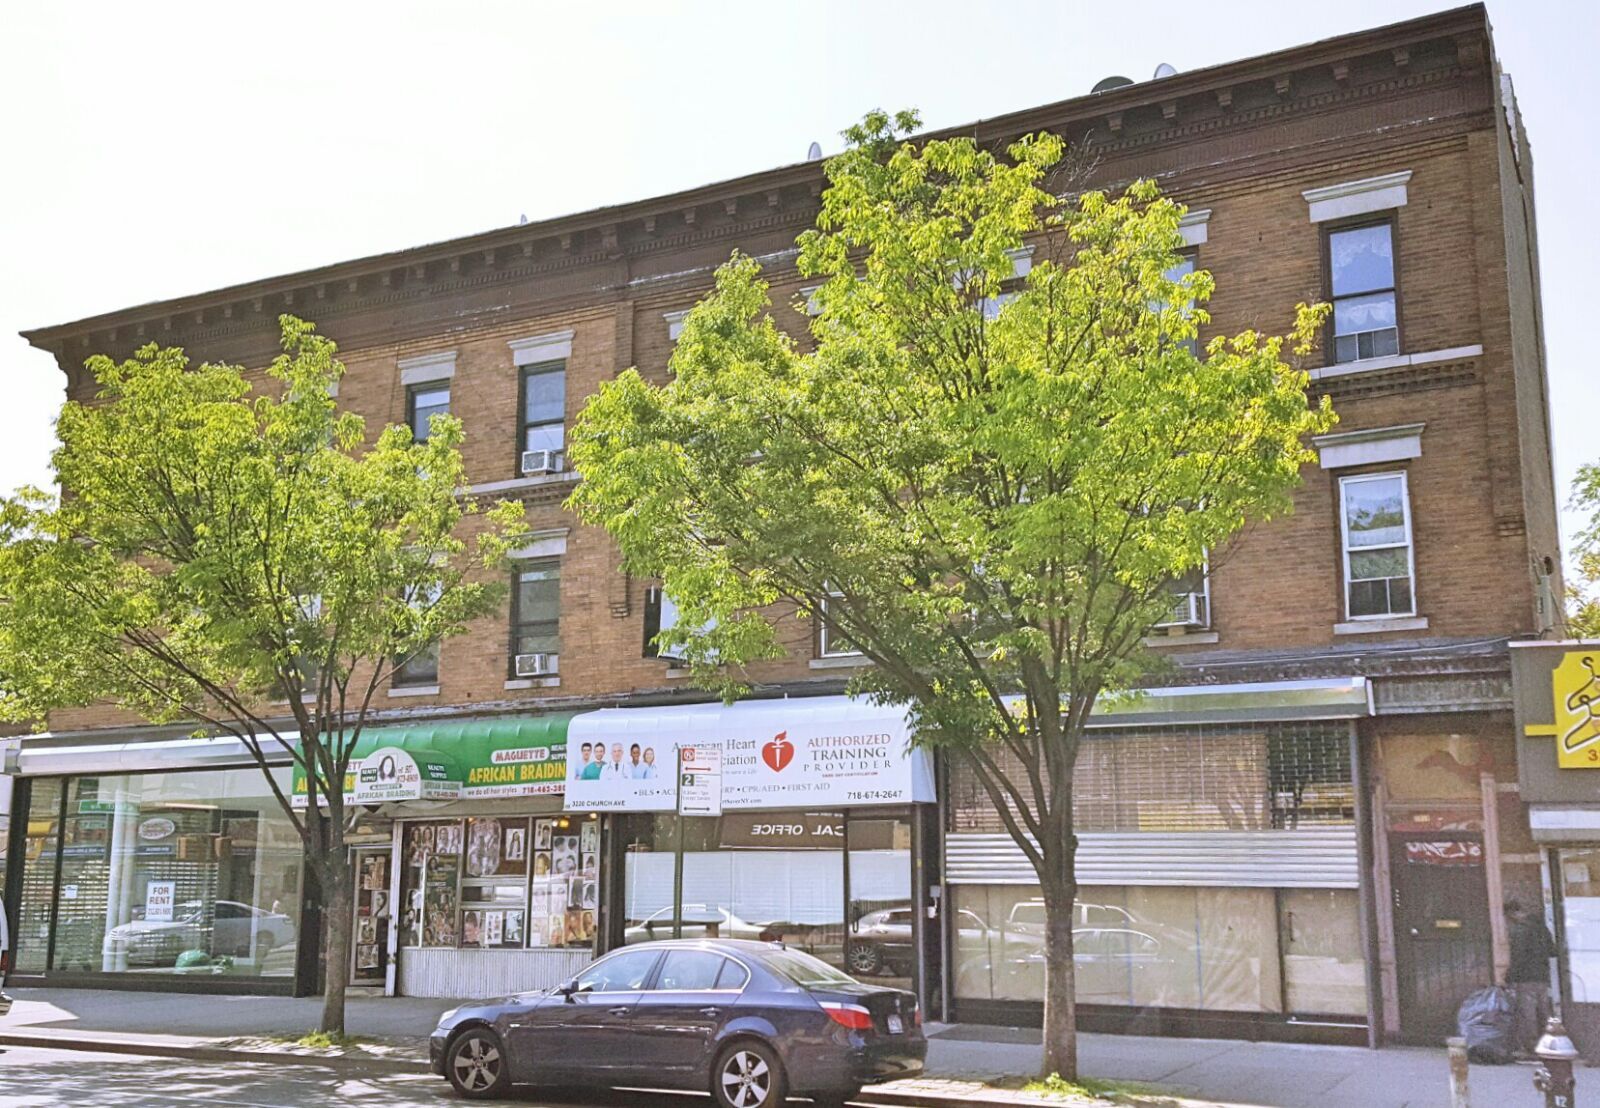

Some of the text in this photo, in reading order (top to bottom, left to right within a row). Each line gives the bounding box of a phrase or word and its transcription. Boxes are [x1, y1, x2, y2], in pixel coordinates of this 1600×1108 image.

[726, 738, 757, 750] Heart
[808, 734, 891, 748] AUTHORIZED
[495, 749, 546, 762] MAGUETTE
[811, 747, 887, 760] TRAINING
[722, 754, 757, 766] ciation
[803, 760, 892, 772] PROVIDER
[469, 762, 566, 784] AFRICAN BRAIDIN
[684, 775, 692, 785] 2
[639, 788, 655, 796] BLS
[787, 783, 812, 791] FIRST
[813, 782, 831, 791] AID
[847, 790, 903, 799] 718-674-2647
[153, 887, 169, 895] FOR
[149, 896, 170, 905] RENT
